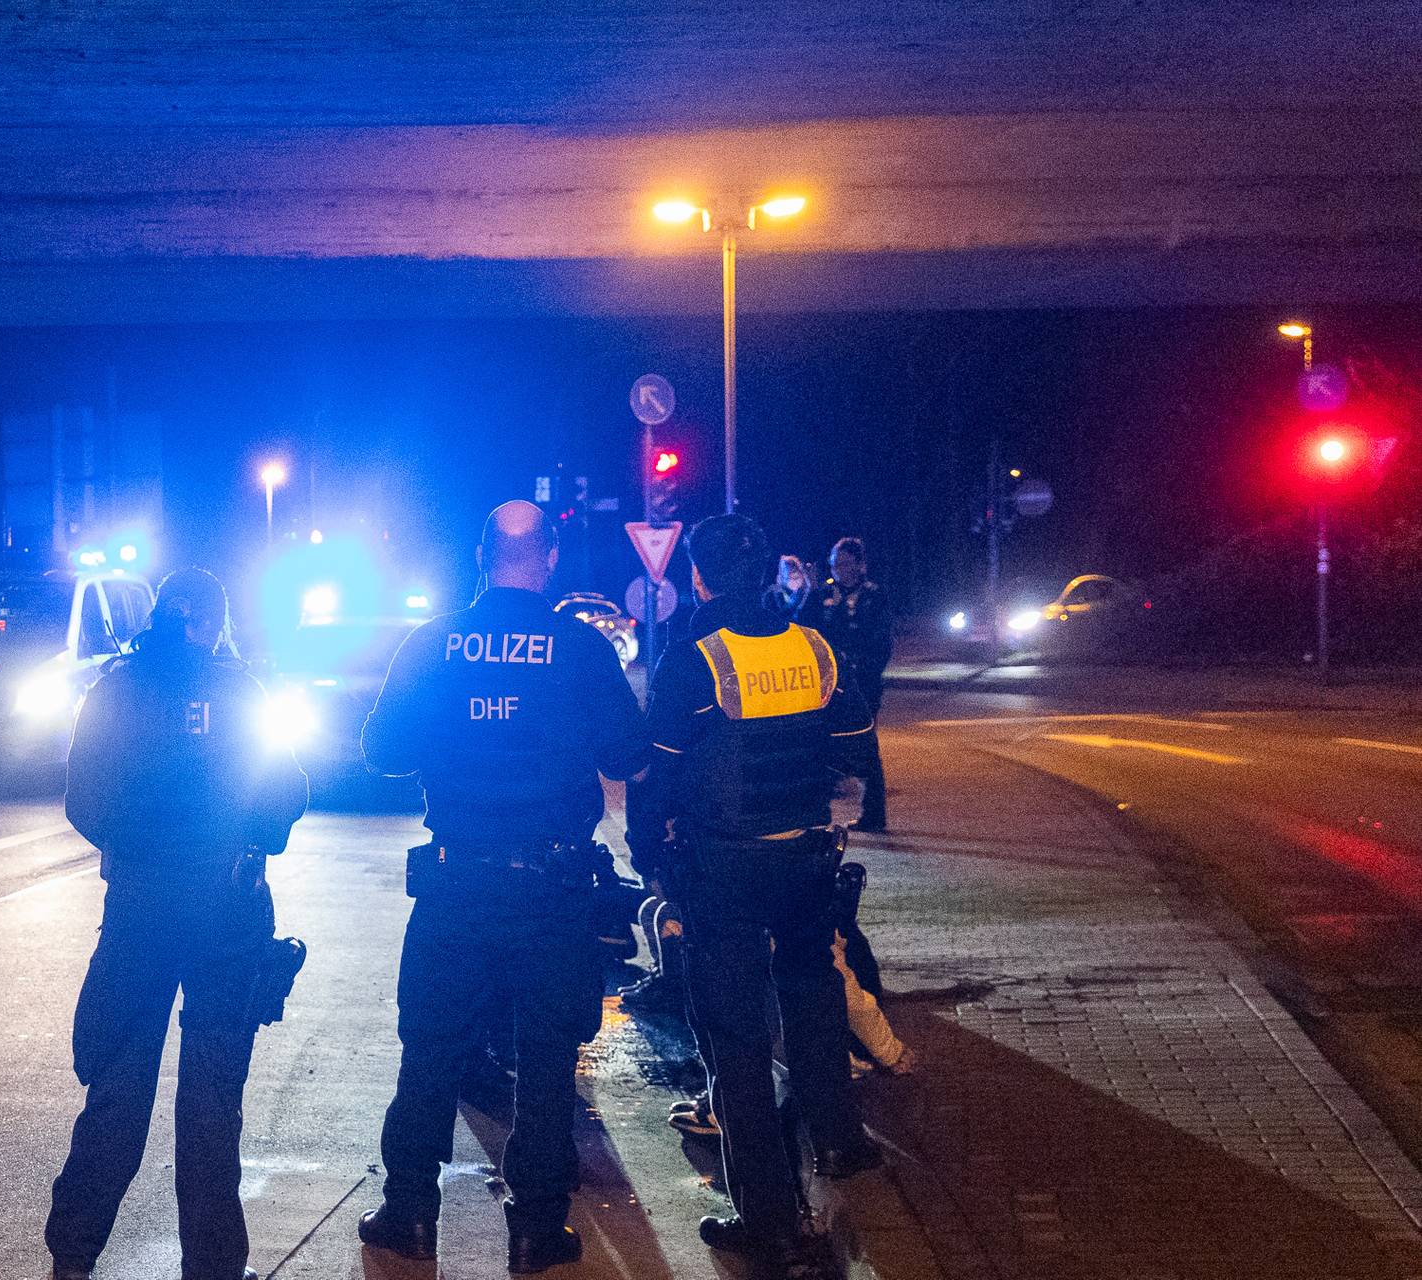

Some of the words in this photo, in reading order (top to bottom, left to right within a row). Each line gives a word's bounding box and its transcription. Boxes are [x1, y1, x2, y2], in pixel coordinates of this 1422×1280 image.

[445, 632, 554, 664] POLIZEI
[746, 664, 815, 697] POLIZEI
[470, 696, 519, 720] DHF
